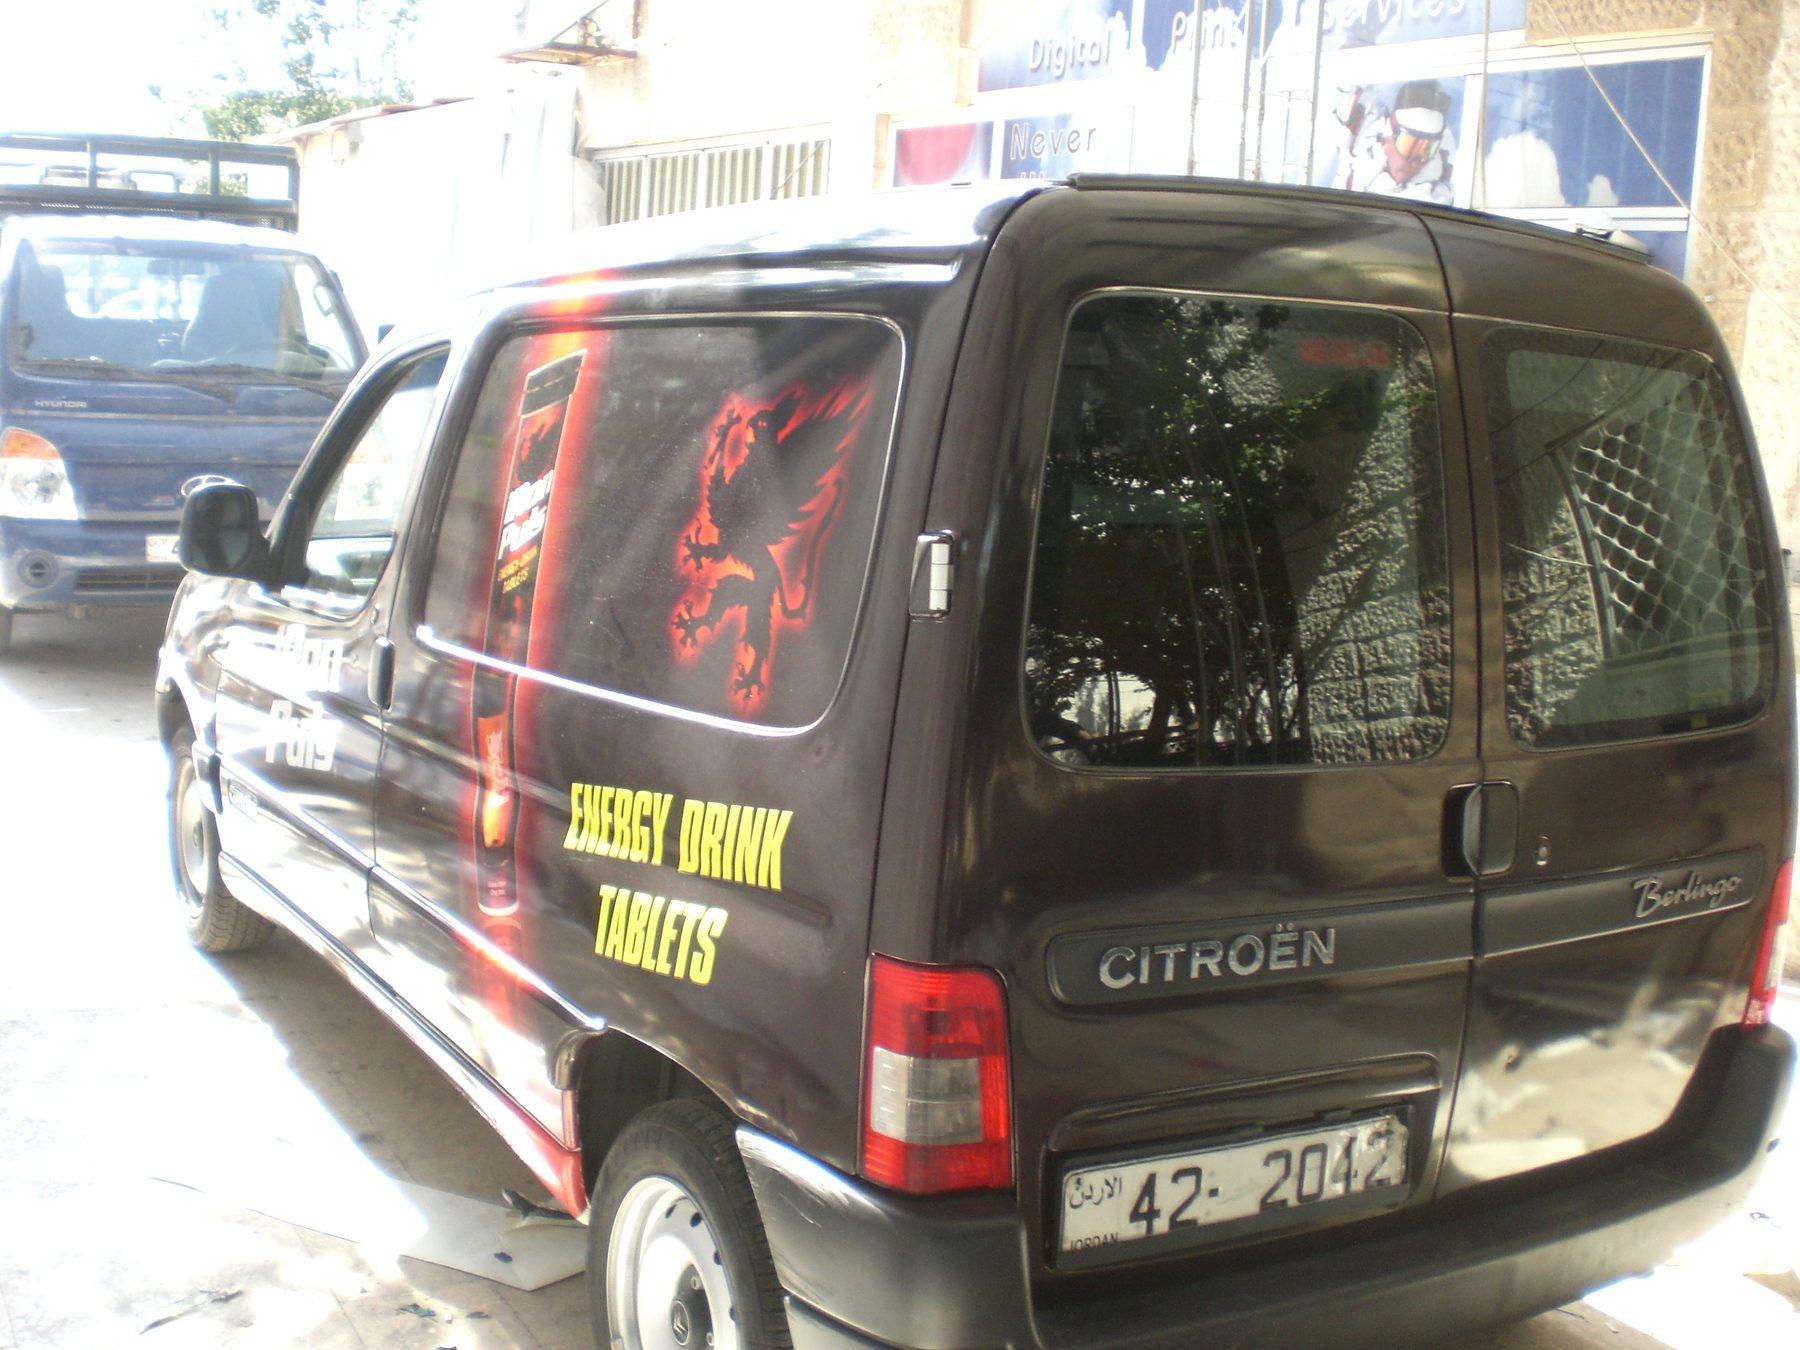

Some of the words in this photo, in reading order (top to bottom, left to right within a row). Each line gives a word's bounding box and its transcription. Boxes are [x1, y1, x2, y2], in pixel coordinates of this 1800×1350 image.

[1028, 28, 1112, 77] Digital
[1009, 122, 1097, 161] Never
[563, 783, 673, 866] ENERGY
[678, 799, 793, 891] DRINK
[1633, 868, 1743, 918] Berlingo
[595, 884, 728, 985] TABLETS
[1099, 922, 1336, 989] CITROËN
